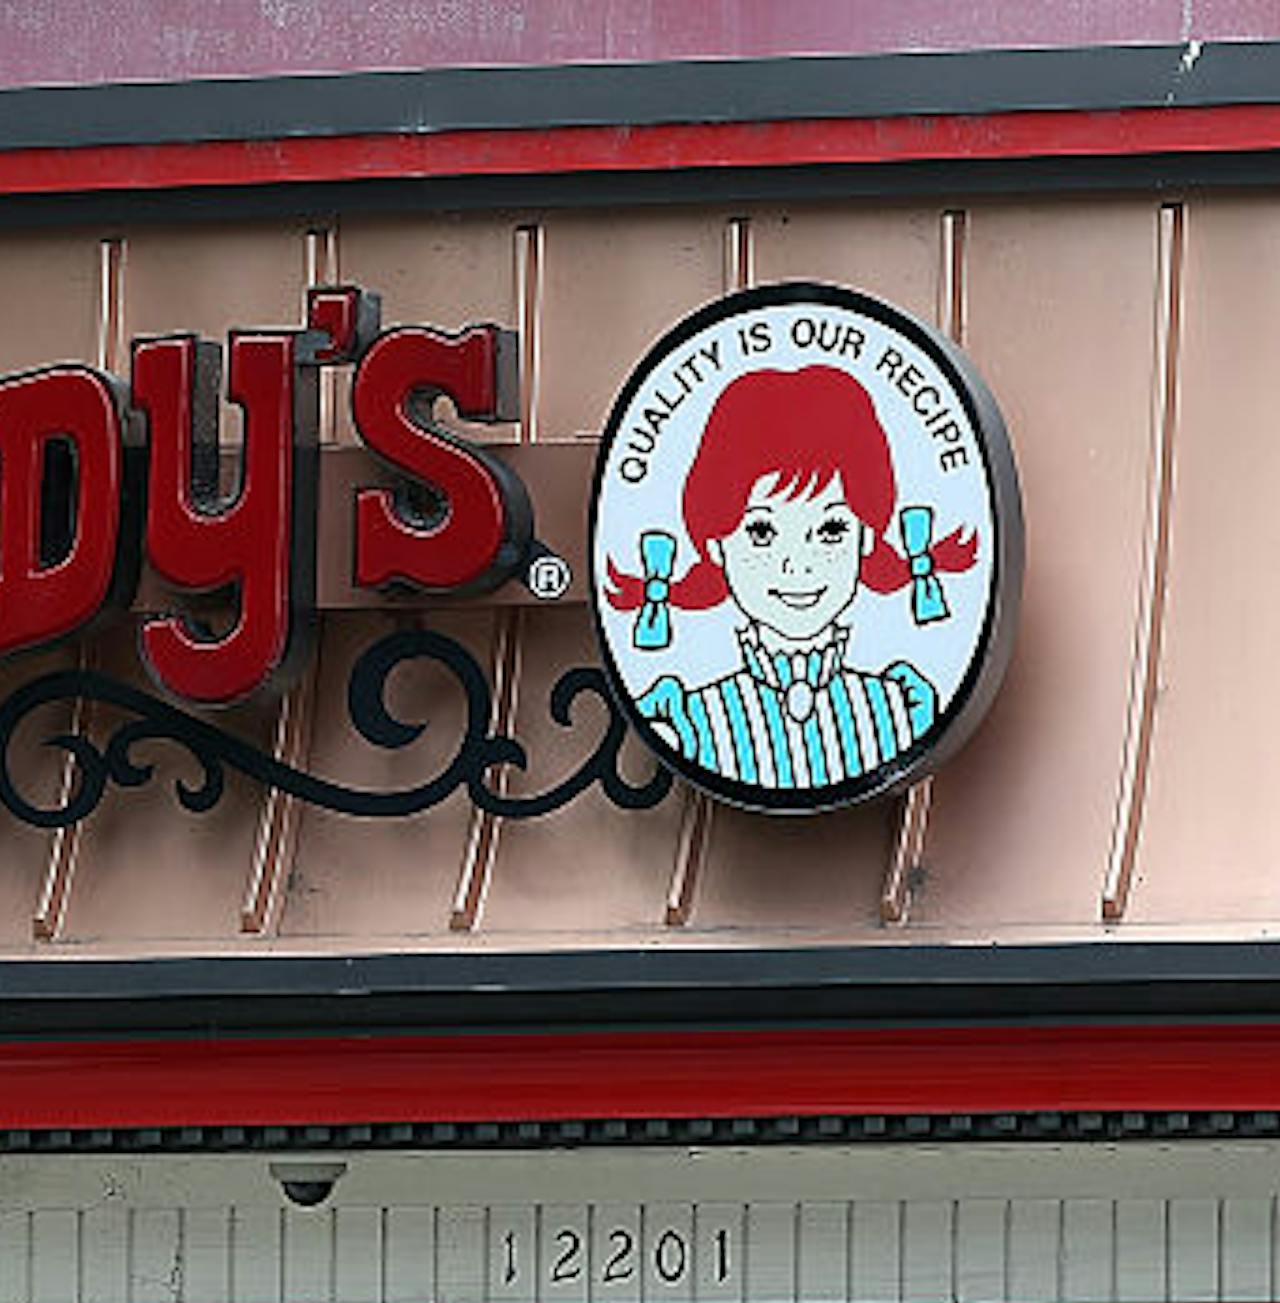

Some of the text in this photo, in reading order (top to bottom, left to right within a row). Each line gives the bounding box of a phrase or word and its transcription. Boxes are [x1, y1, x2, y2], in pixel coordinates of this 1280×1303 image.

[620, 318, 970, 482] QUALITY IS OUR RECIPE
[504, 1230, 728, 1283] 12201
